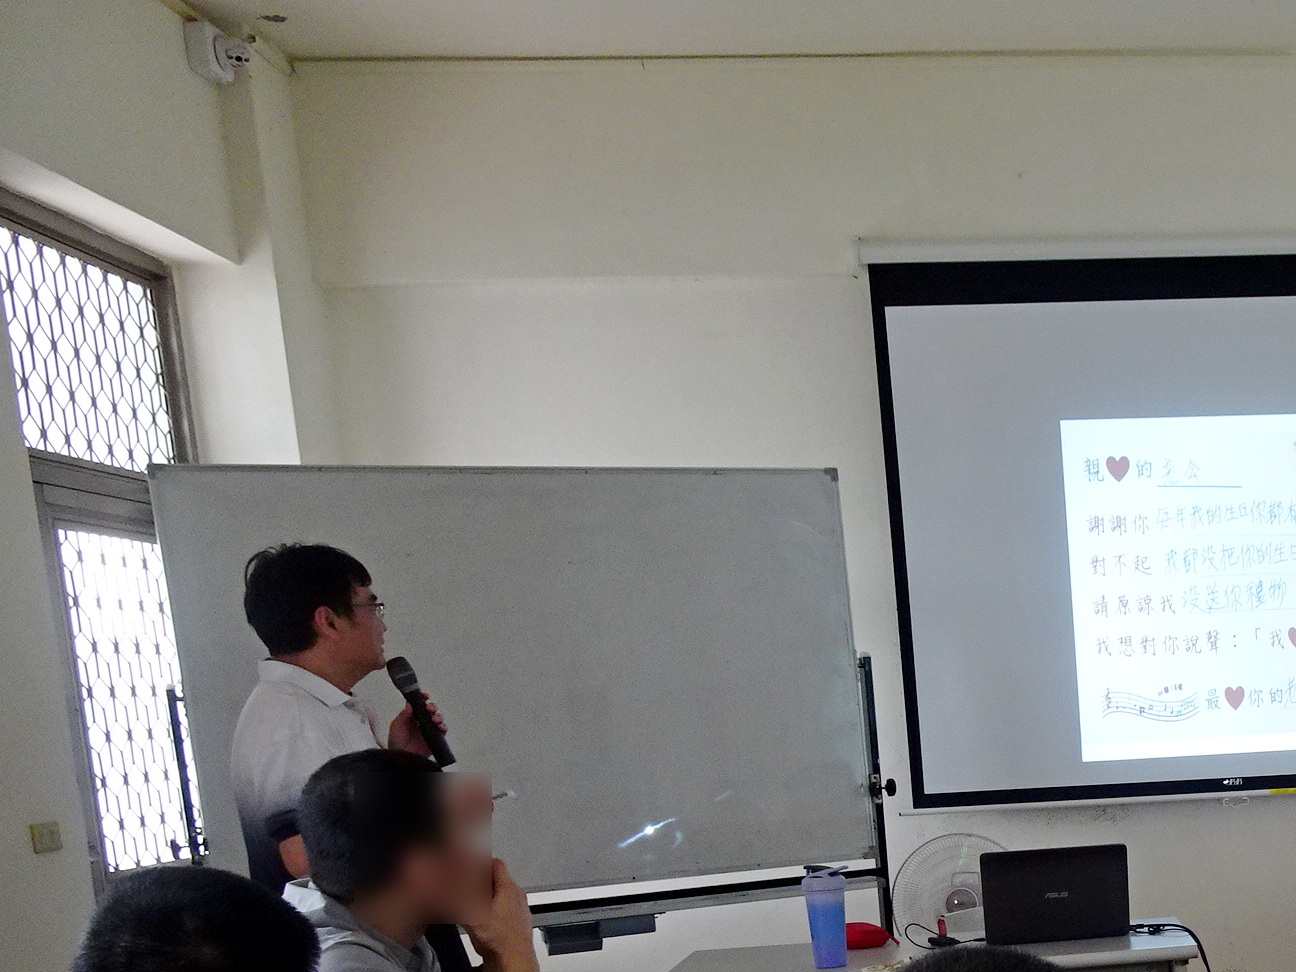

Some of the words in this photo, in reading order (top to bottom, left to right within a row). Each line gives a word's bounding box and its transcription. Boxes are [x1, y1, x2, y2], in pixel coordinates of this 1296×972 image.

[1089, 553, 1152, 576] 對不起
[1205, 688, 1221, 711] 最
